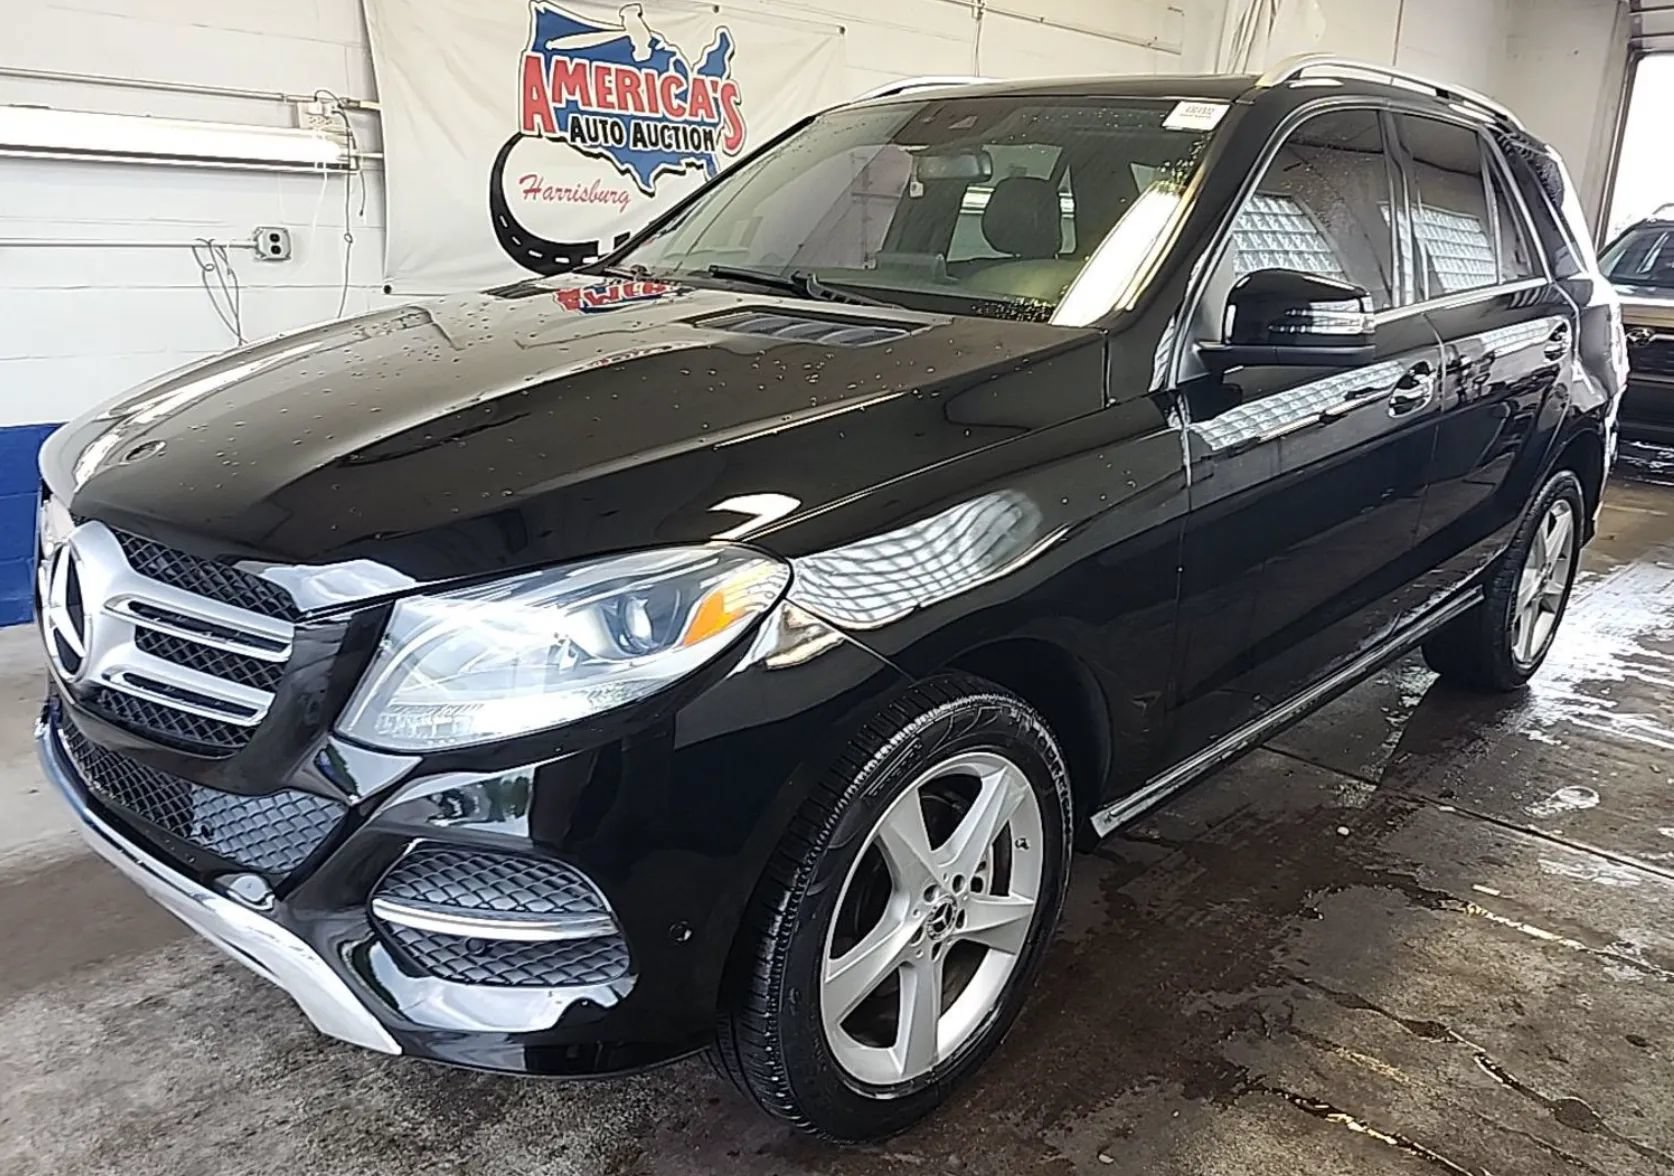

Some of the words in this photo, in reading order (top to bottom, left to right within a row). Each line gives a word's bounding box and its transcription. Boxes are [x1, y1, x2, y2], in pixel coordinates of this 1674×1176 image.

[521, 53, 744, 154] AMERICA'S
[569, 115, 625, 146] AUTO
[632, 122, 716, 151] AUCTION
[518, 173, 633, 213] Harrisburg
